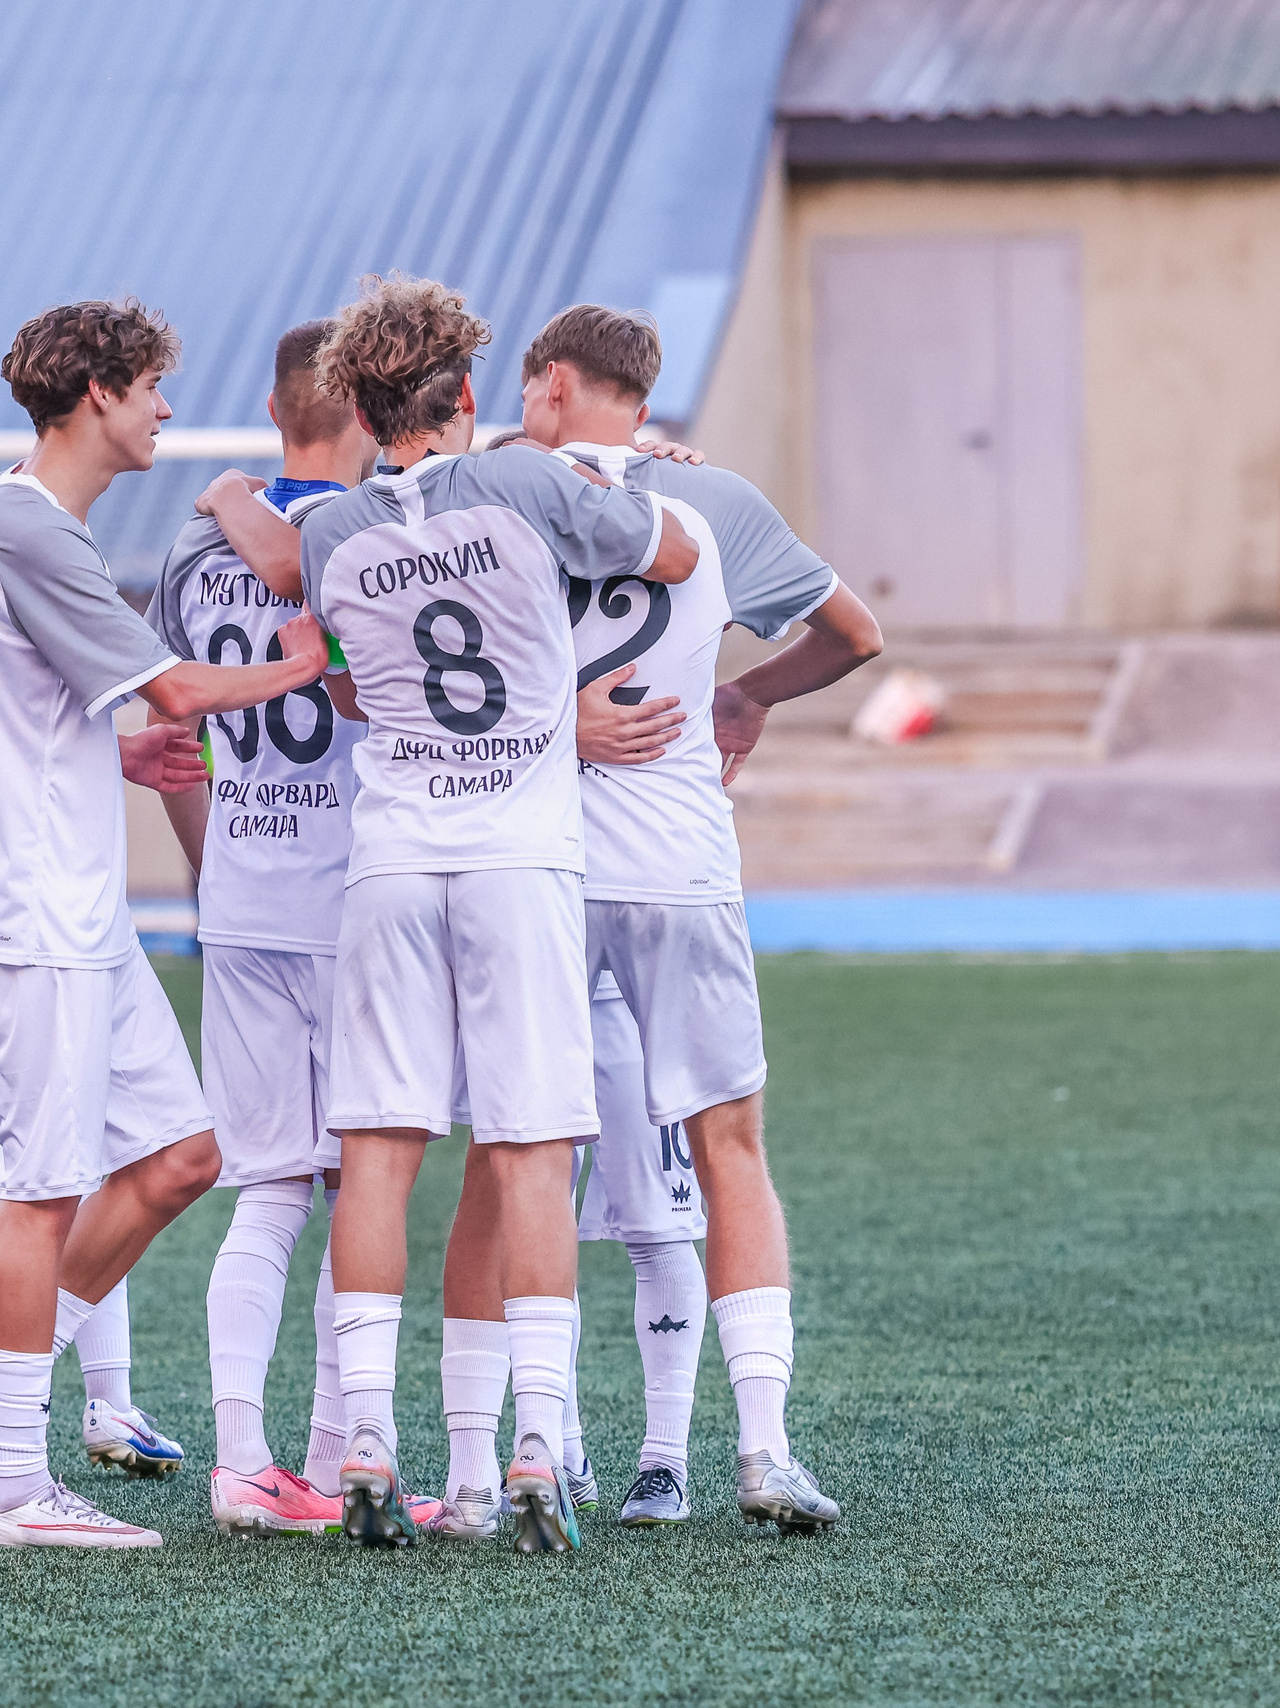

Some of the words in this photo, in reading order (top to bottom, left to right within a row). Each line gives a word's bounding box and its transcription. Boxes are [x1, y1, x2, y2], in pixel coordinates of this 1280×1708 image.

[286, 481, 310, 492] PRO
[358, 536, 501, 600] СОРОКИН
[412, 599, 507, 736] 8
[428, 768, 514, 799] САМАРА
[228, 814, 299, 839] САМАРА
